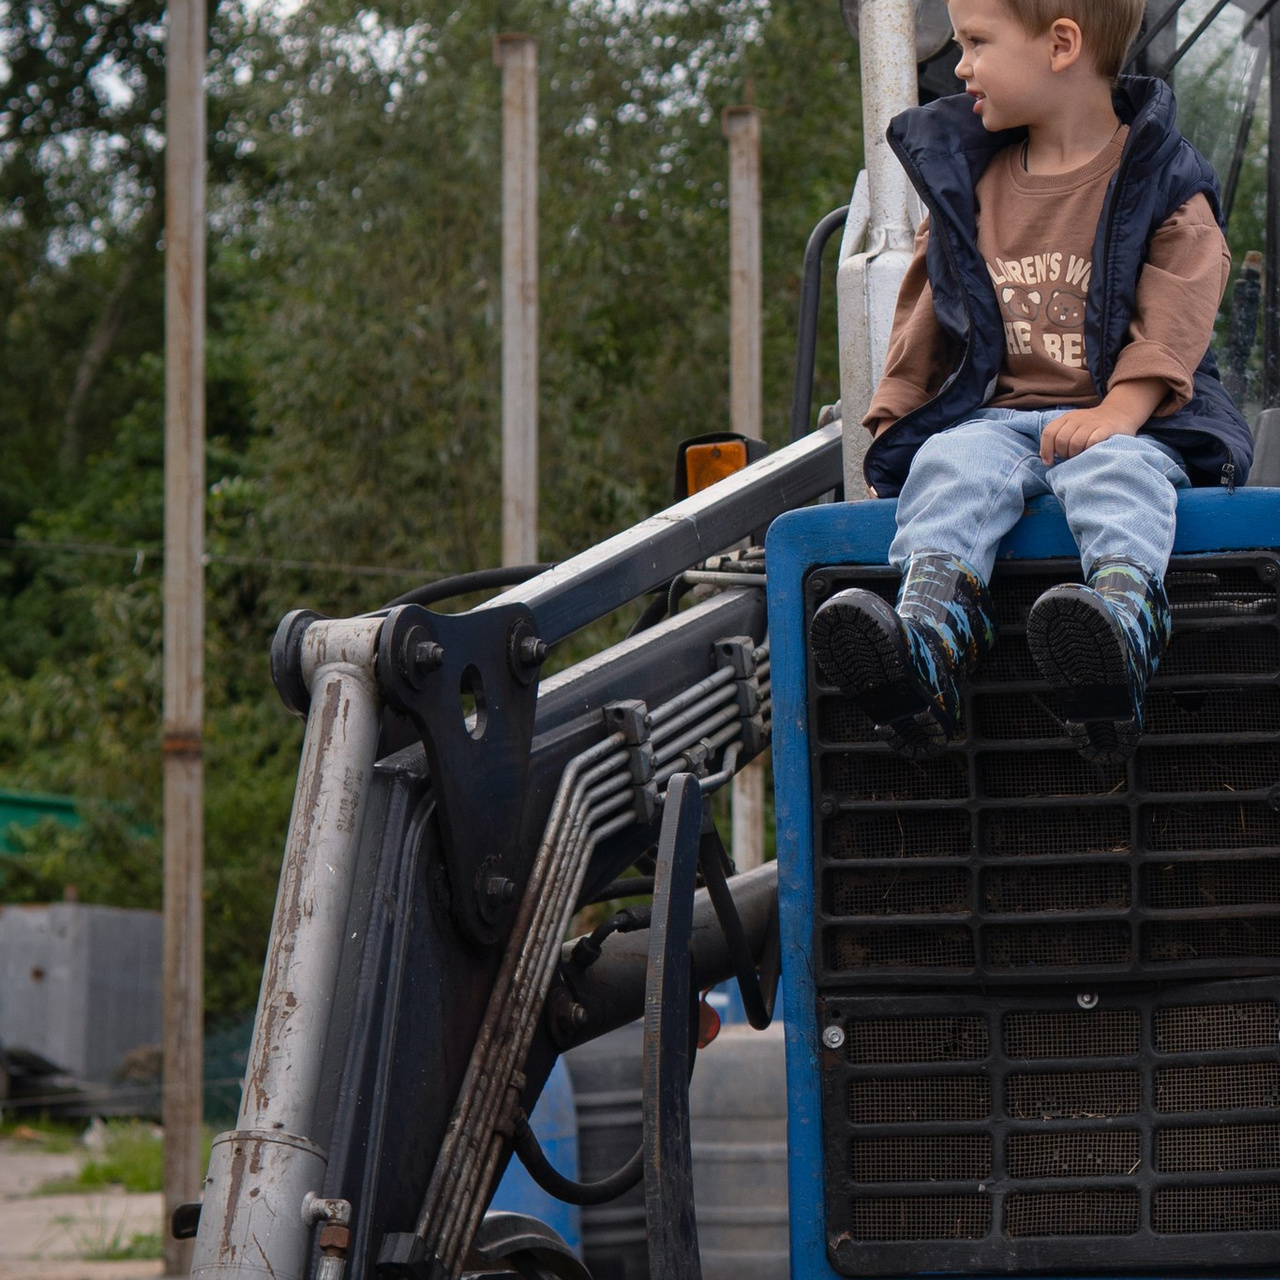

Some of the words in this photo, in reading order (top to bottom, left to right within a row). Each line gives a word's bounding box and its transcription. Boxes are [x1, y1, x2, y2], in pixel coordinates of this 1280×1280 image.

[986, 252, 1062, 287] LDREN'S
[1003, 321, 1032, 355] HE
[1043, 333, 1088, 368] BE
